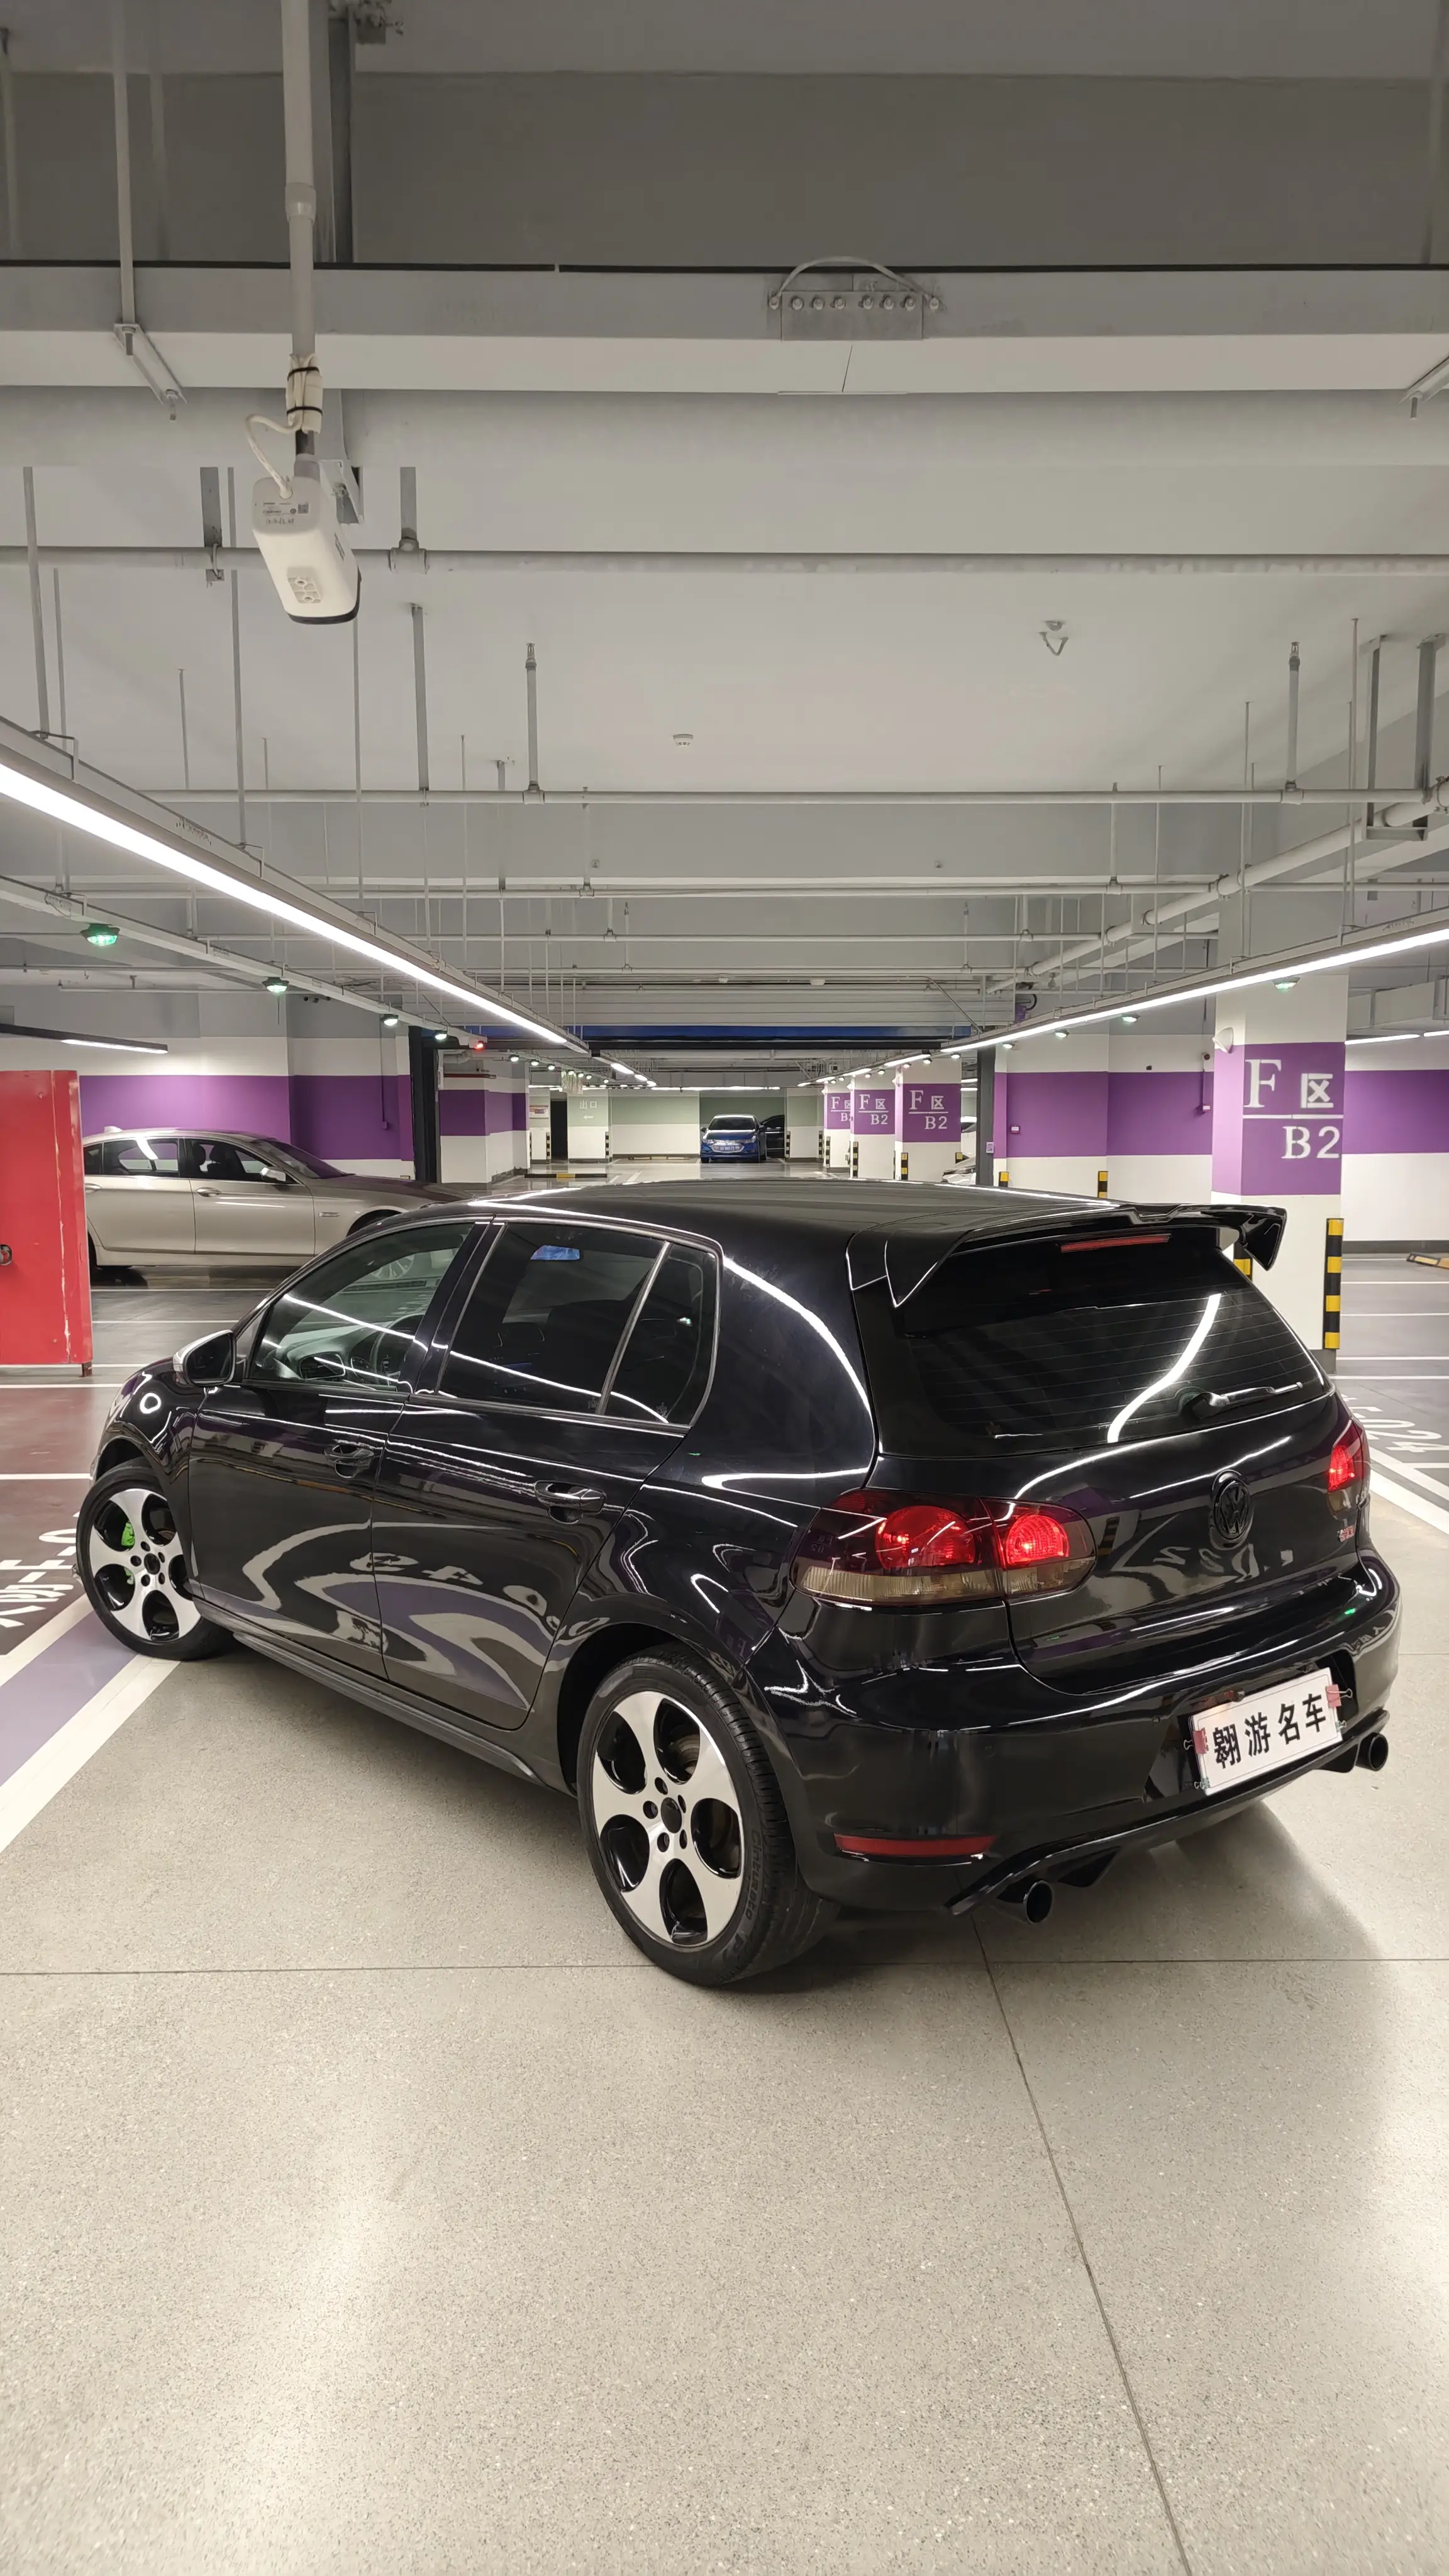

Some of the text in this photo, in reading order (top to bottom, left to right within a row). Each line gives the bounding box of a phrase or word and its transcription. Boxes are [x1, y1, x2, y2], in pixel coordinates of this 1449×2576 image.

[1243, 1058, 1334, 1109] F区
[579, 1099, 597, 1109] 出口
[909, 1090, 944, 1110] F区
[870, 1114, 888, 1124] B2
[924, 1116, 947, 1130] B2
[1280, 1126, 1340, 1159] B2
